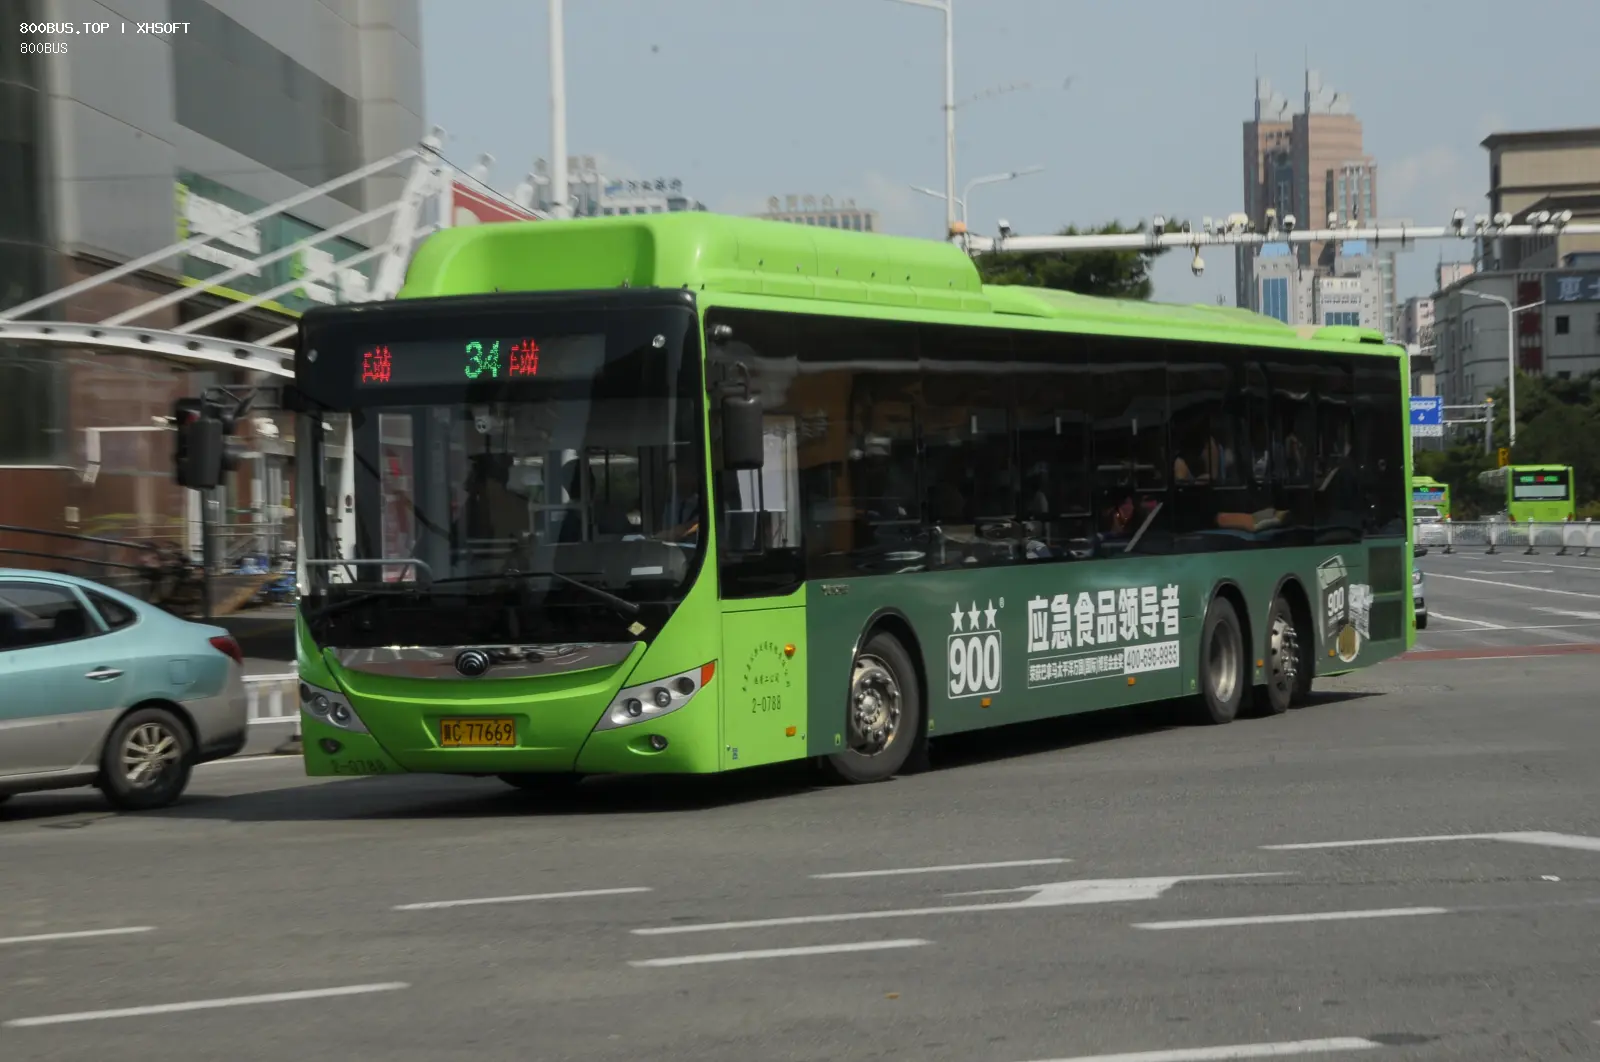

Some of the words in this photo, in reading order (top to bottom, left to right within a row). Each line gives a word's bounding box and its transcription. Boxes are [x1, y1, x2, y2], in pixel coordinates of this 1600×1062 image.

[464, 340, 502, 379] 34
[1027, 583, 1180, 654] 应急食品领导者
[1327, 585, 1345, 617] 900
[949, 634, 1001, 695] 900
[751, 694, 782, 714] 2-0788
